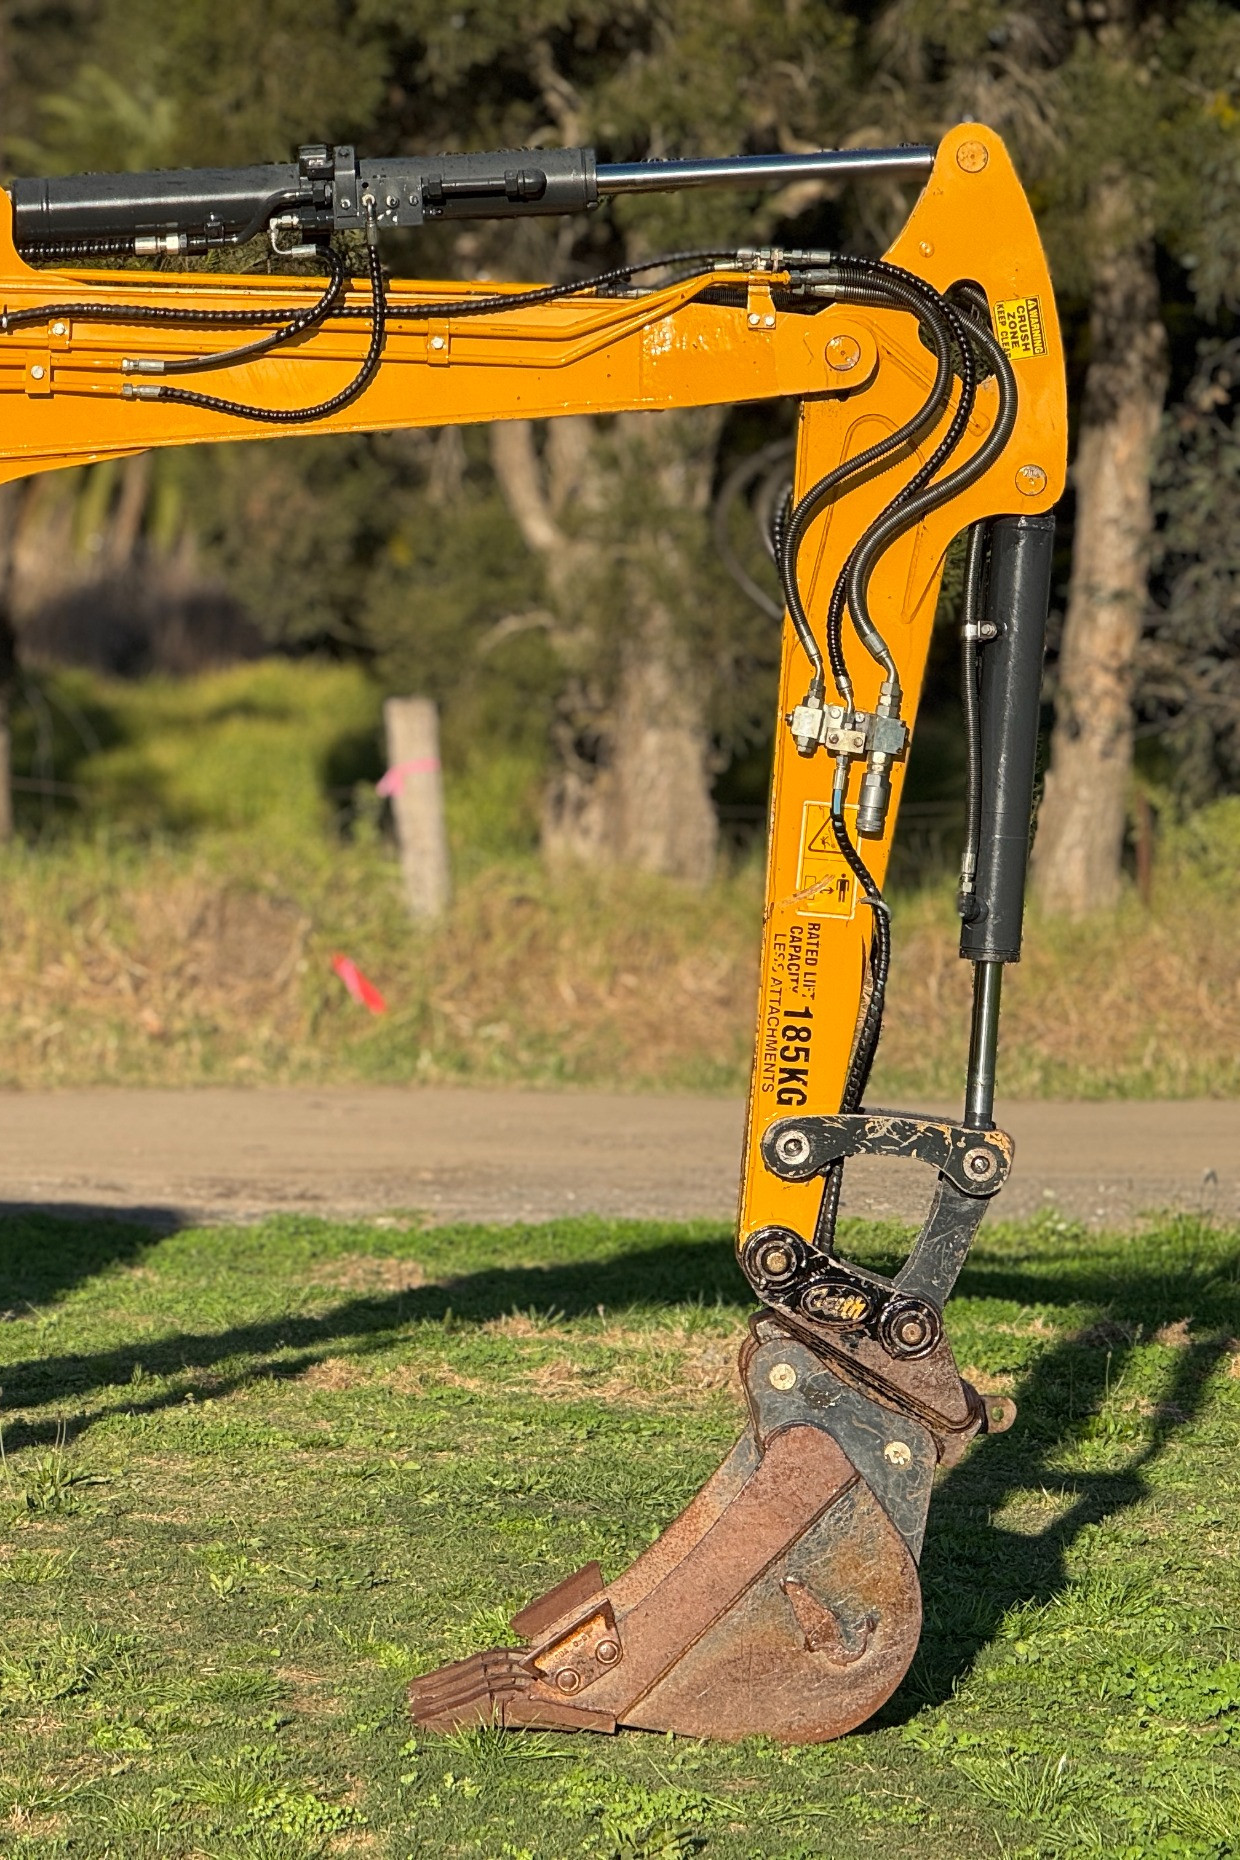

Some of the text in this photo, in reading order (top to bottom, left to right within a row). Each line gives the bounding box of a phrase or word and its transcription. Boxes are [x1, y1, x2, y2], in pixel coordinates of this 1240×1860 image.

[996, 303, 1006, 326] KEEP
[1007, 311, 1020, 349] ZONE
[1016, 305, 1031, 352] CRUSH
[1028, 308, 1044, 354] WARNING
[786, 926, 804, 994] CAPACITY
[804, 922, 821, 966] RATED
[762, 933, 787, 1093] LESS ATTACHMENTS
[776, 1005, 814, 1107] 185KG
